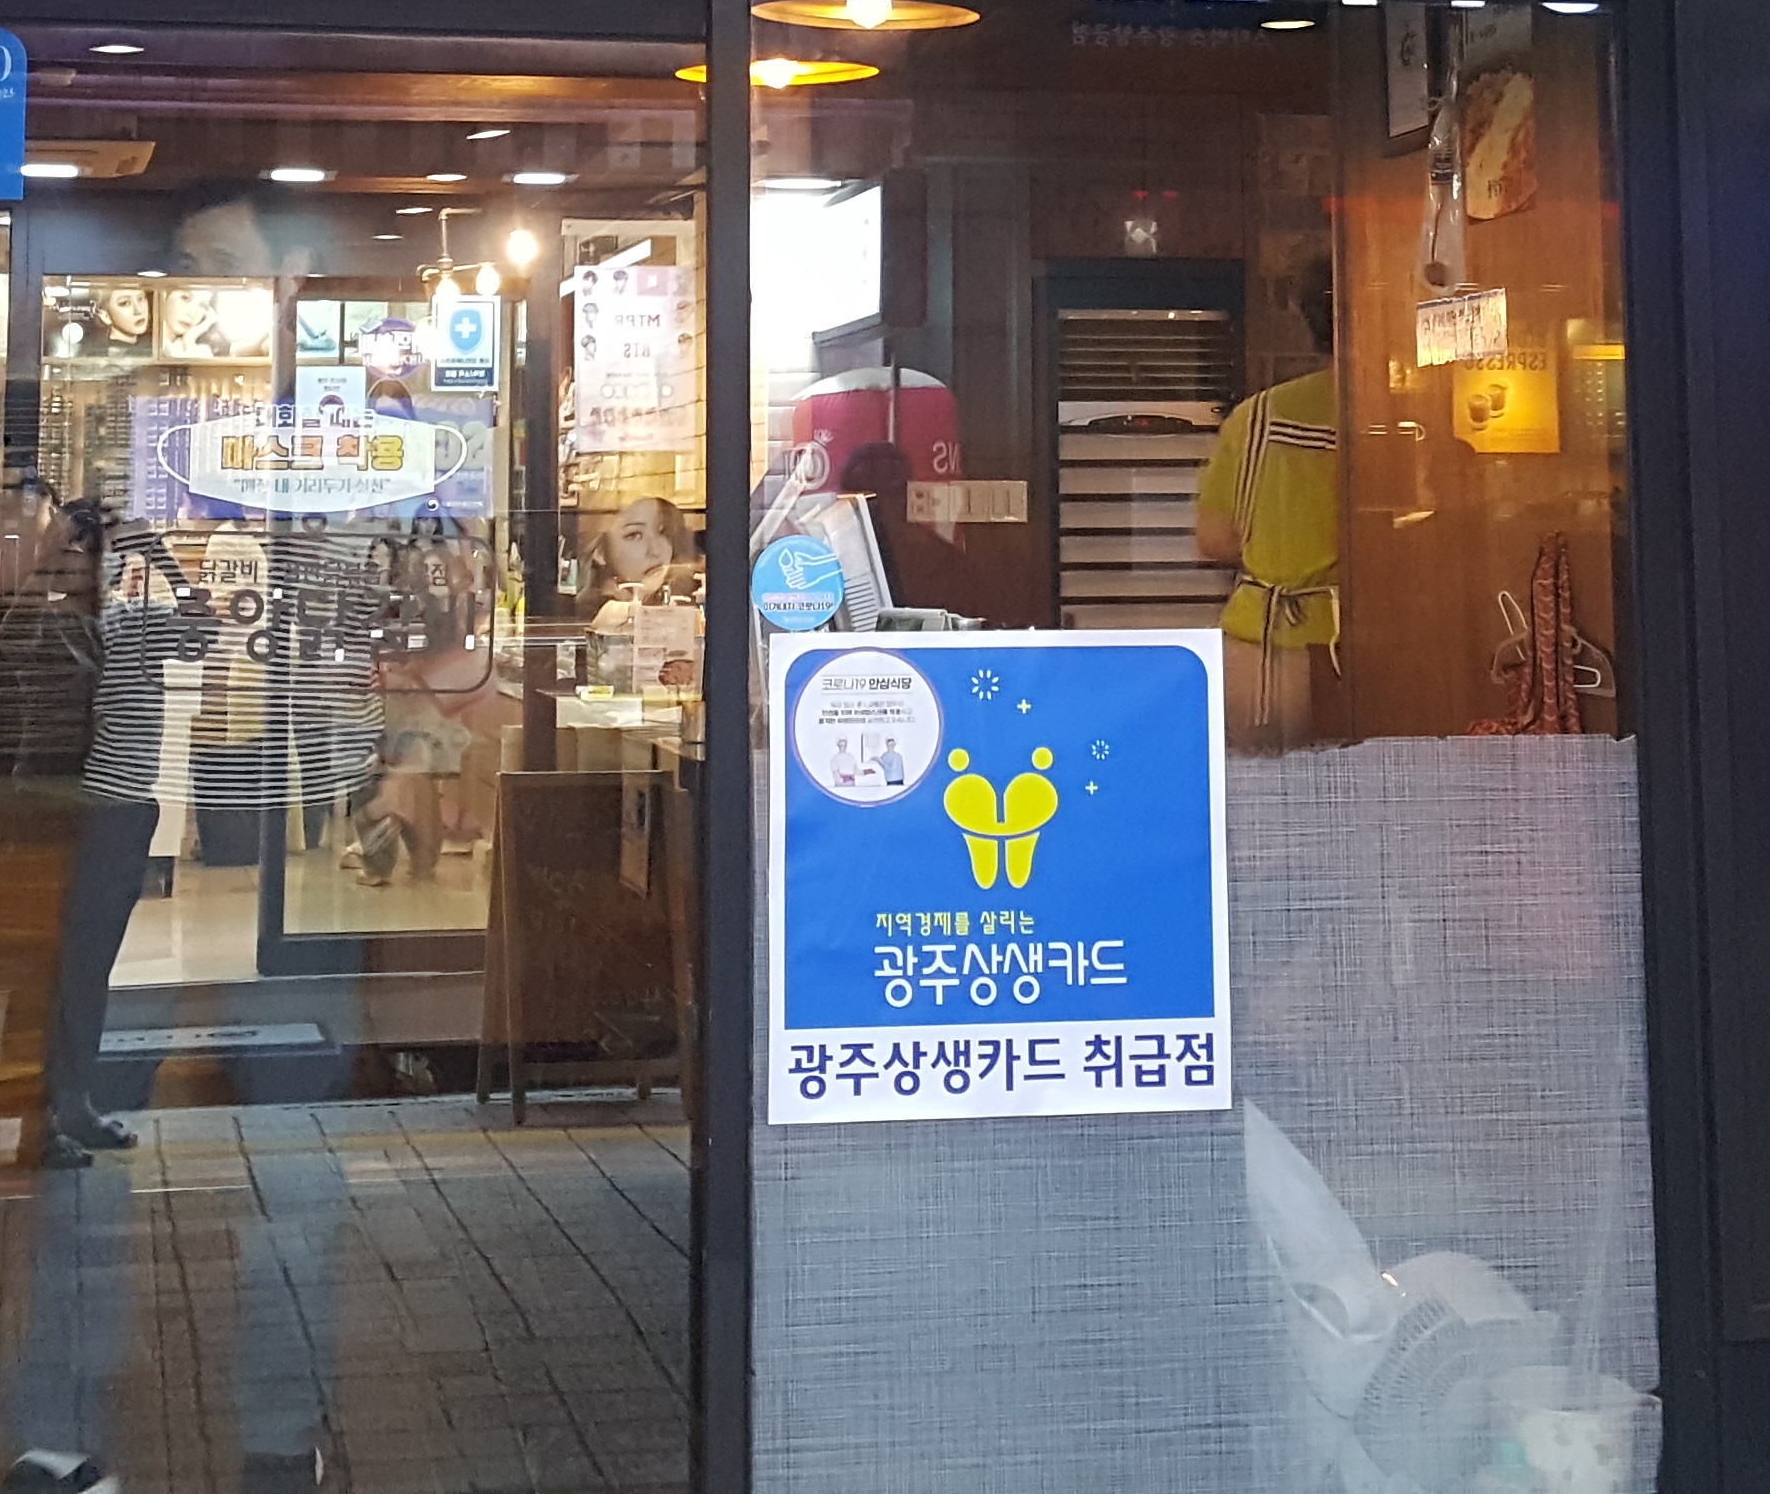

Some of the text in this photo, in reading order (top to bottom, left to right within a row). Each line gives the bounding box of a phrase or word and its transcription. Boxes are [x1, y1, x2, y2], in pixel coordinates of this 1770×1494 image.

[220, 434, 405, 471] 마스크 착용
[821, 676, 913, 691] 코로나19 안심식당
[876, 910, 1035, 937] 지역경제를 살리는
[873, 940, 1127, 1008] 광주상생카드
[787, 1032, 1216, 1100] 광주상생카드 취급점
